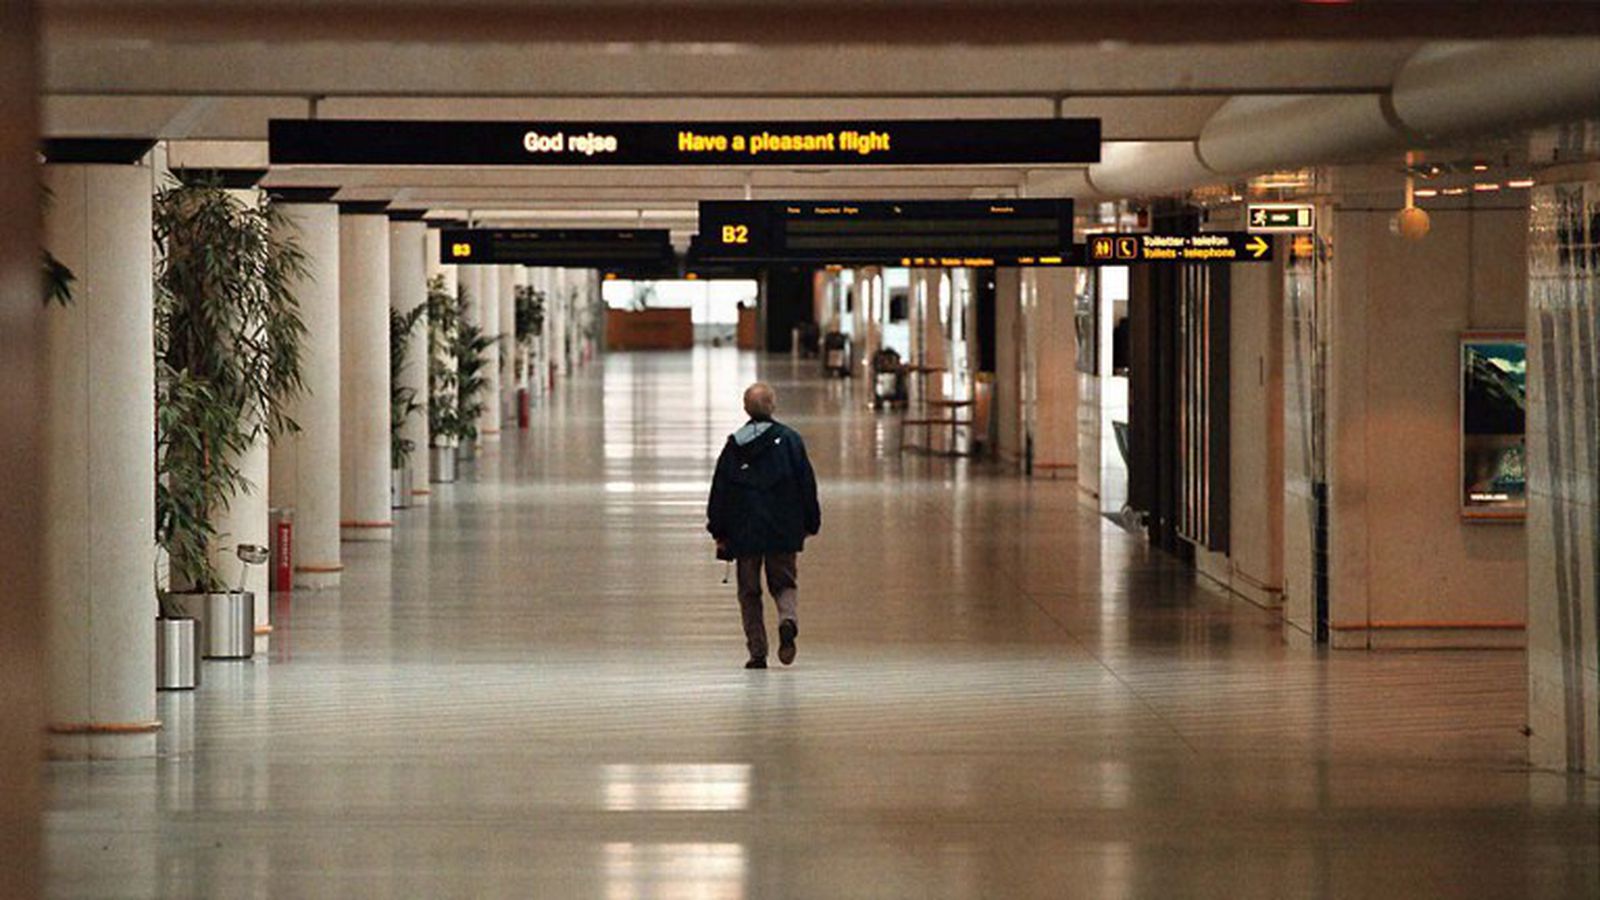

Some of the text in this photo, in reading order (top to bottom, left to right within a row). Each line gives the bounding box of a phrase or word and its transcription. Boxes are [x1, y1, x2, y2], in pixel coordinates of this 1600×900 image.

[524, 131, 617, 155] God rejse
[678, 131, 890, 154] Have a pleasant flight
[722, 224, 748, 243] B2
[1143, 247, 1176, 258] Toilets
[1184, 247, 1235, 260] telephone
